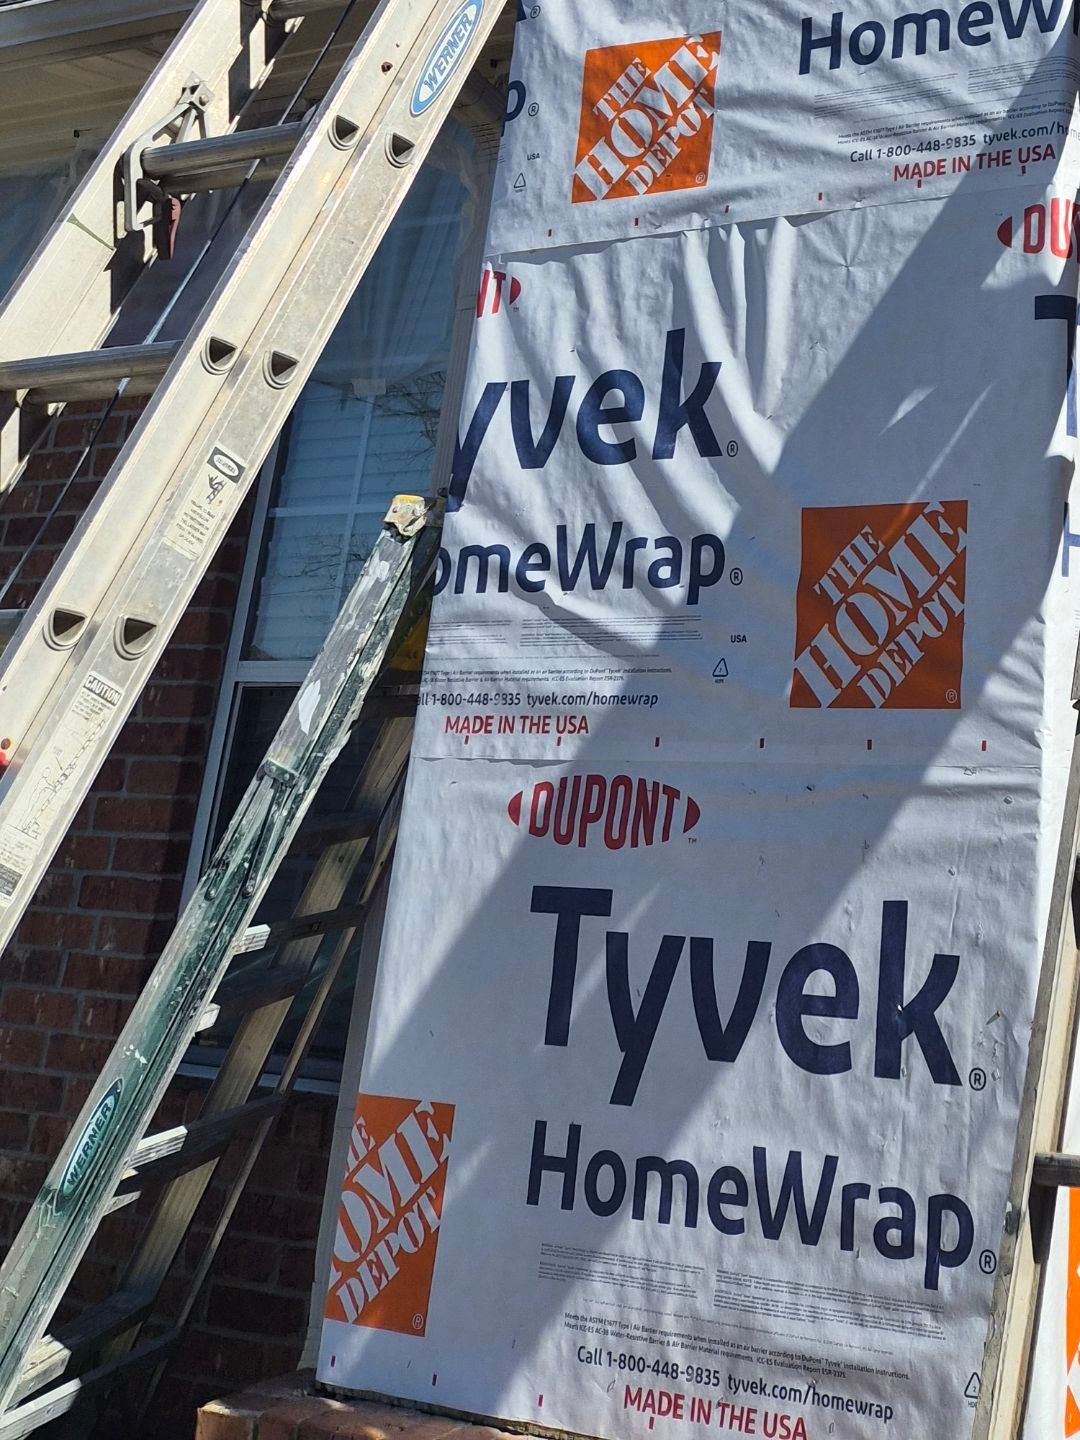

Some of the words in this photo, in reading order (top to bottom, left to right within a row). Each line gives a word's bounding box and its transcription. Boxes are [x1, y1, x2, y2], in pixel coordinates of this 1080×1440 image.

[424, 13, 473, 92] WERNER
[593, 57, 651, 122] THE
[527, 152, 541, 160] USA
[574, 34, 720, 200] HOME
[625, 87, 716, 195] DEPOT
[850, 148, 873, 162] Call
[877, 135, 976, 159] 1-800-448-9835
[893, 161, 946, 182] MADE
[952, 156, 971, 175] IN
[976, 150, 1012, 171] THE
[1018, 143, 1056, 164] USA
[813, 524, 885, 605] THE
[730, 634, 747, 644] USA
[794, 500, 967, 708] HOME
[857, 575, 966, 708] DEPOT
[86, 675, 121, 706] CAUTION
[431, 693, 521, 707] 1-800-448-9835
[527, 691, 658, 709] tyvek.com/homewrap
[445, 715, 494, 734] MADE
[498, 715, 516, 734] IN
[520, 716, 551, 734] THE
[556, 715, 589, 734] USA
[528, 774, 680, 850] DUPONT
[530, 886, 962, 1106] Tyvek
[67, 1102, 112, 1186] WERNER
[329, 1099, 451, 1291] OME
[526, 1120, 975, 1291] HomeWrap
[336, 1186, 440, 1324] DEPOT
[577, 1345, 602, 1366] Call
[607, 1351, 720, 1387] 1-800-448-9835
[728, 1374, 893, 1423] tyvek.com/homewrap
[624, 1385, 684, 1420] MADE
[690, 1397, 711, 1423] IN
[717, 1401, 757, 1434] THE
[763, 1411, 807, 1440] USA
